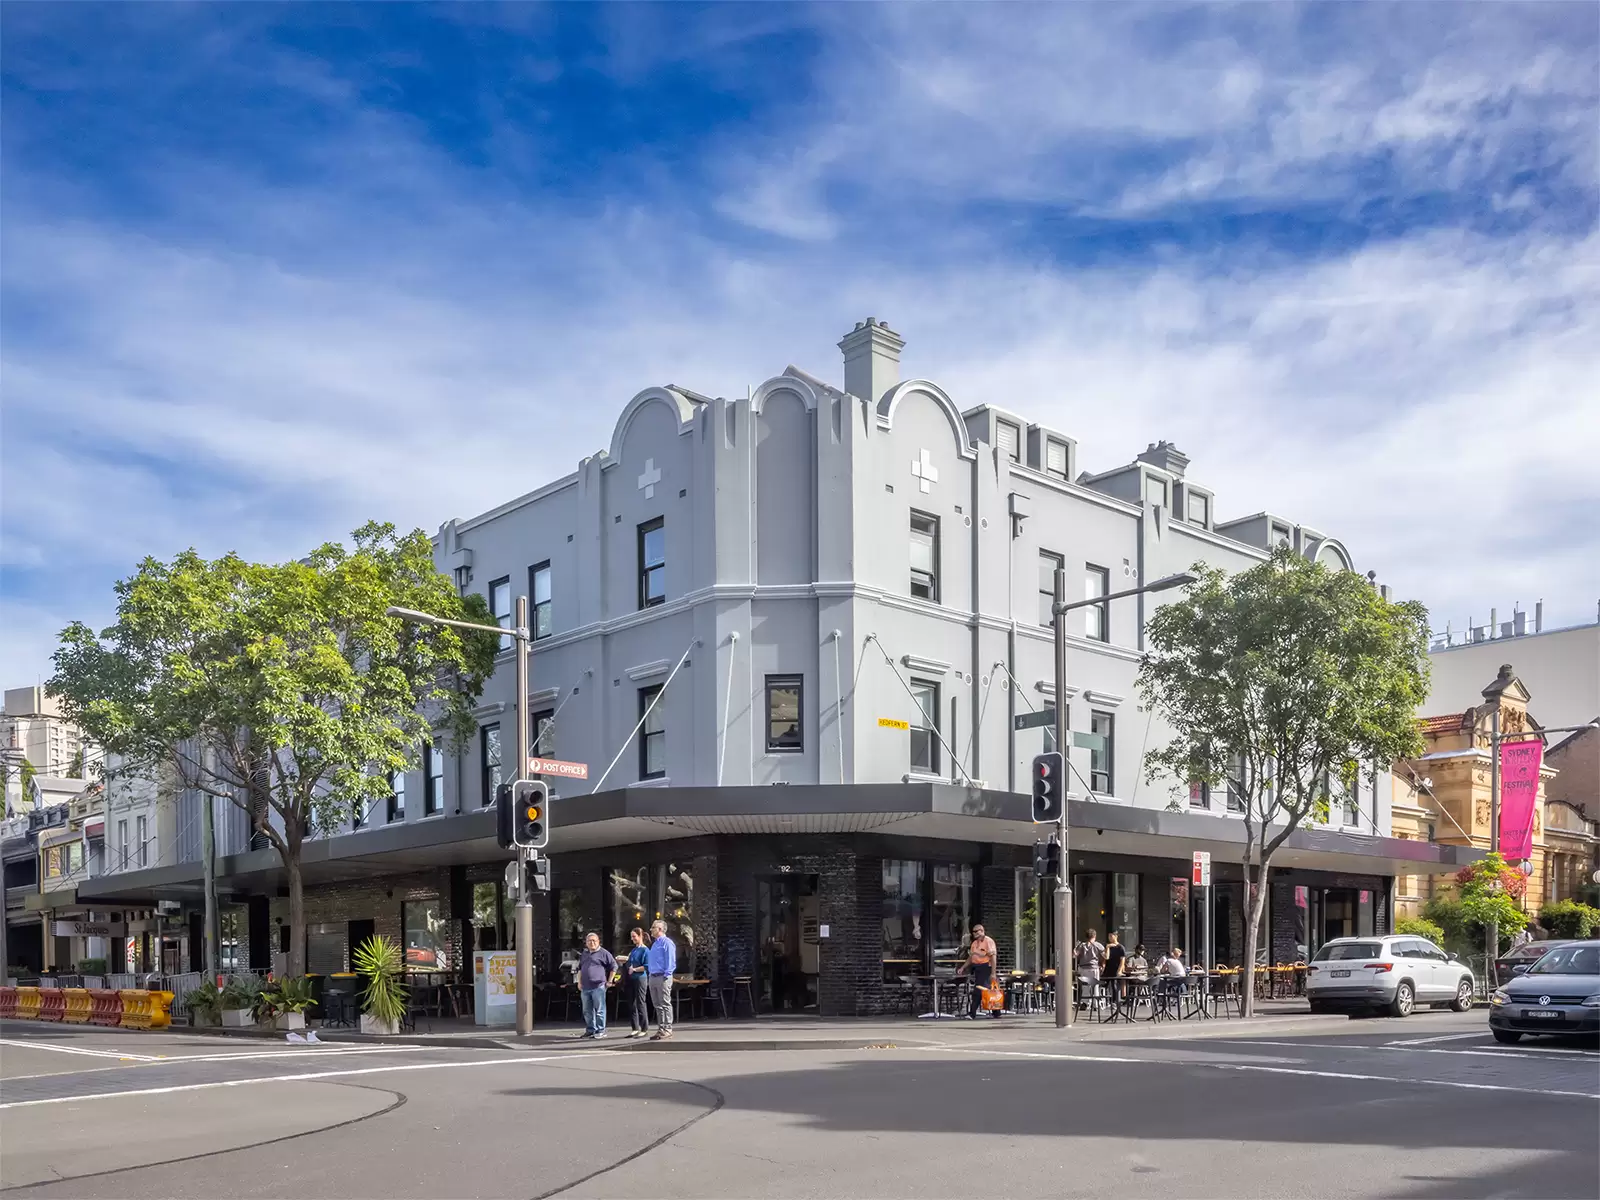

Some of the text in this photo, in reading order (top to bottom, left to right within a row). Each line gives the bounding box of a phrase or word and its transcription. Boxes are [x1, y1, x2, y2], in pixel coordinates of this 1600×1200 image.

[1507, 748, 1536, 756] SYDNEY
[543, 762, 581, 775] POST OFFICE
[1503, 780, 1534, 789] FESTIVAL
[74, 922, 82, 934] St
